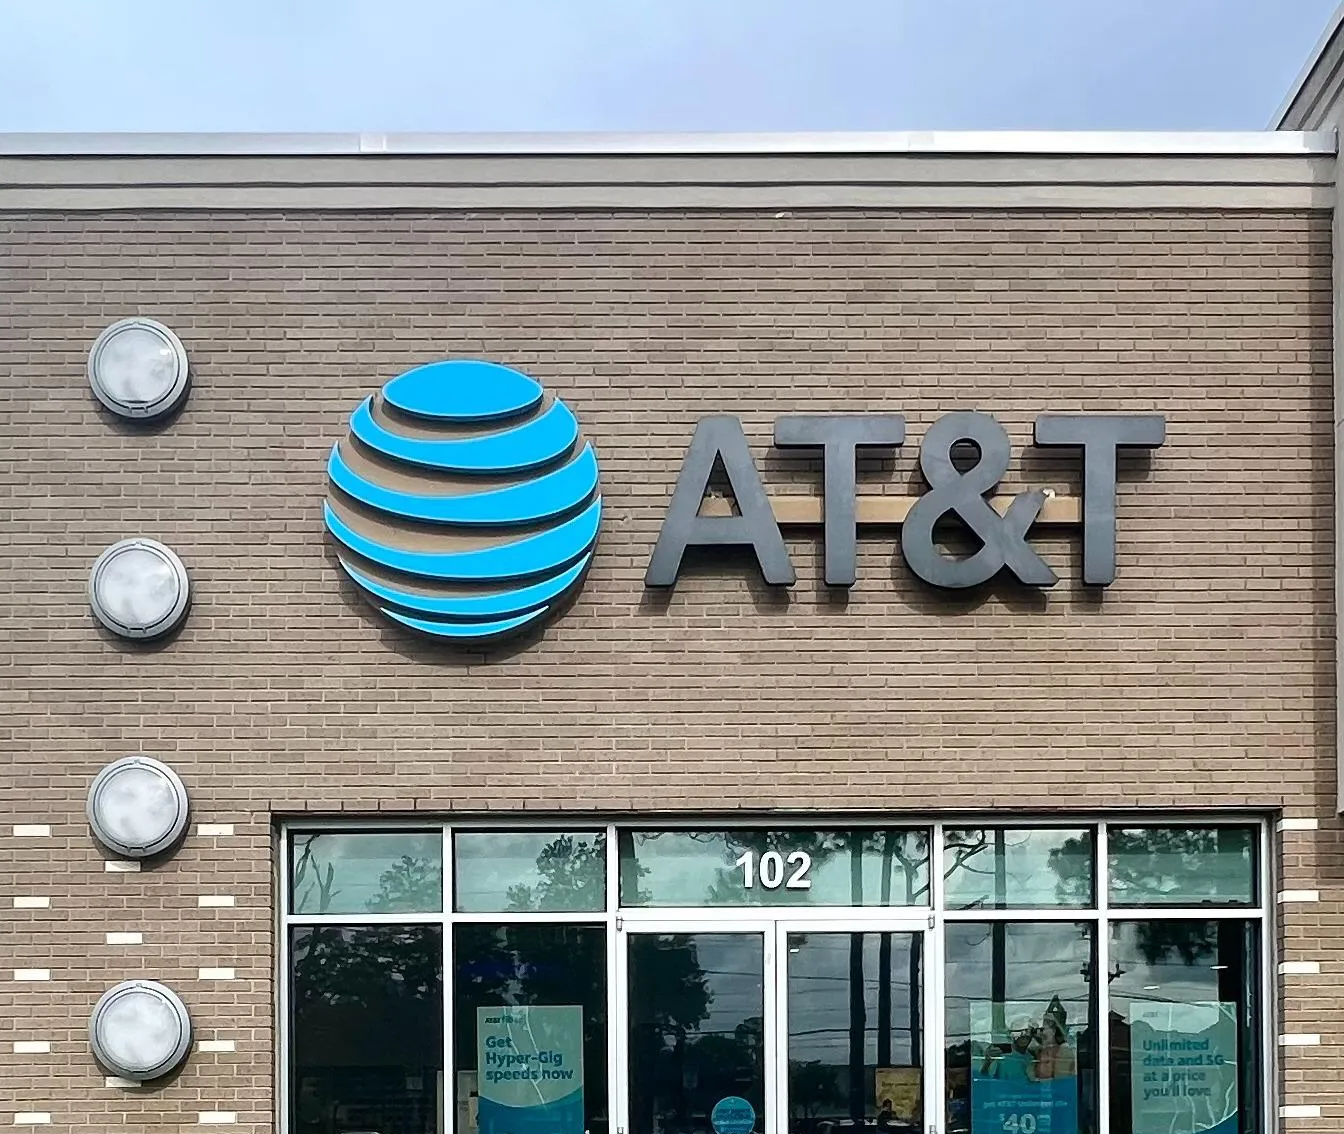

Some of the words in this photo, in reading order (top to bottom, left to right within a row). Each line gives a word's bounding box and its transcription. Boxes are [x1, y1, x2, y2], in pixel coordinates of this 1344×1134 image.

[645, 411, 1165, 587] AT&T
[736, 851, 812, 889] 102
[485, 1035, 512, 1048] Get
[1142, 1038, 1210, 1051] Unlimited
[485, 1051, 563, 1067] Hyper-Gig
[1143, 1054, 1174, 1067] data
[1177, 1054, 1203, 1067] and
[1206, 1054, 1225, 1066] 5G
[485, 1068, 538, 1083] speeds
[542, 1069, 574, 1080] now
[1143, 1071, 1157, 1082] at
[1161, 1072, 1170, 1082] a
[1172, 1070, 1206, 1085] price
[1182, 1084, 1212, 1097] love
